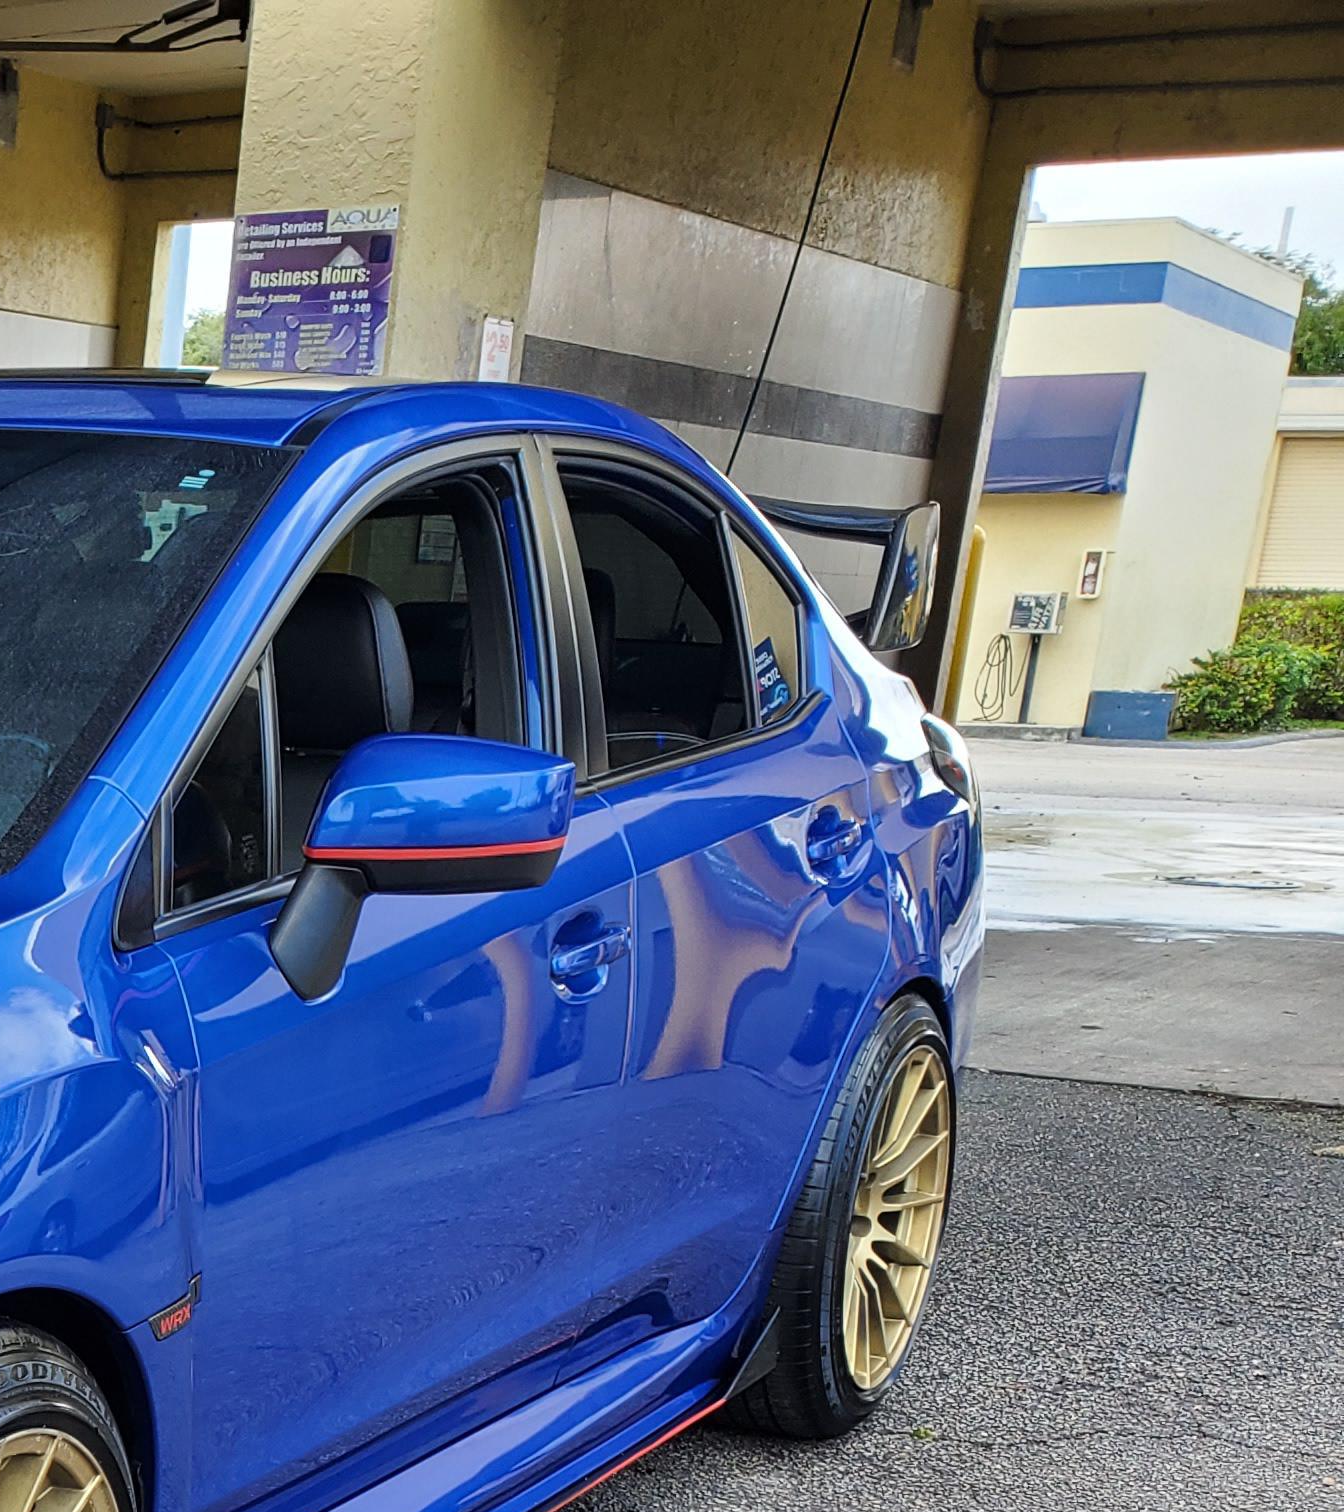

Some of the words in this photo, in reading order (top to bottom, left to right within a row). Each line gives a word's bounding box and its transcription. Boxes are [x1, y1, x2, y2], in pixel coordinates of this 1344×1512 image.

[281, 220, 324, 235] Services
[250, 268, 319, 288] Business
[320, 266, 371, 285] Hours:
[160, 1303, 192, 1335] WRX
